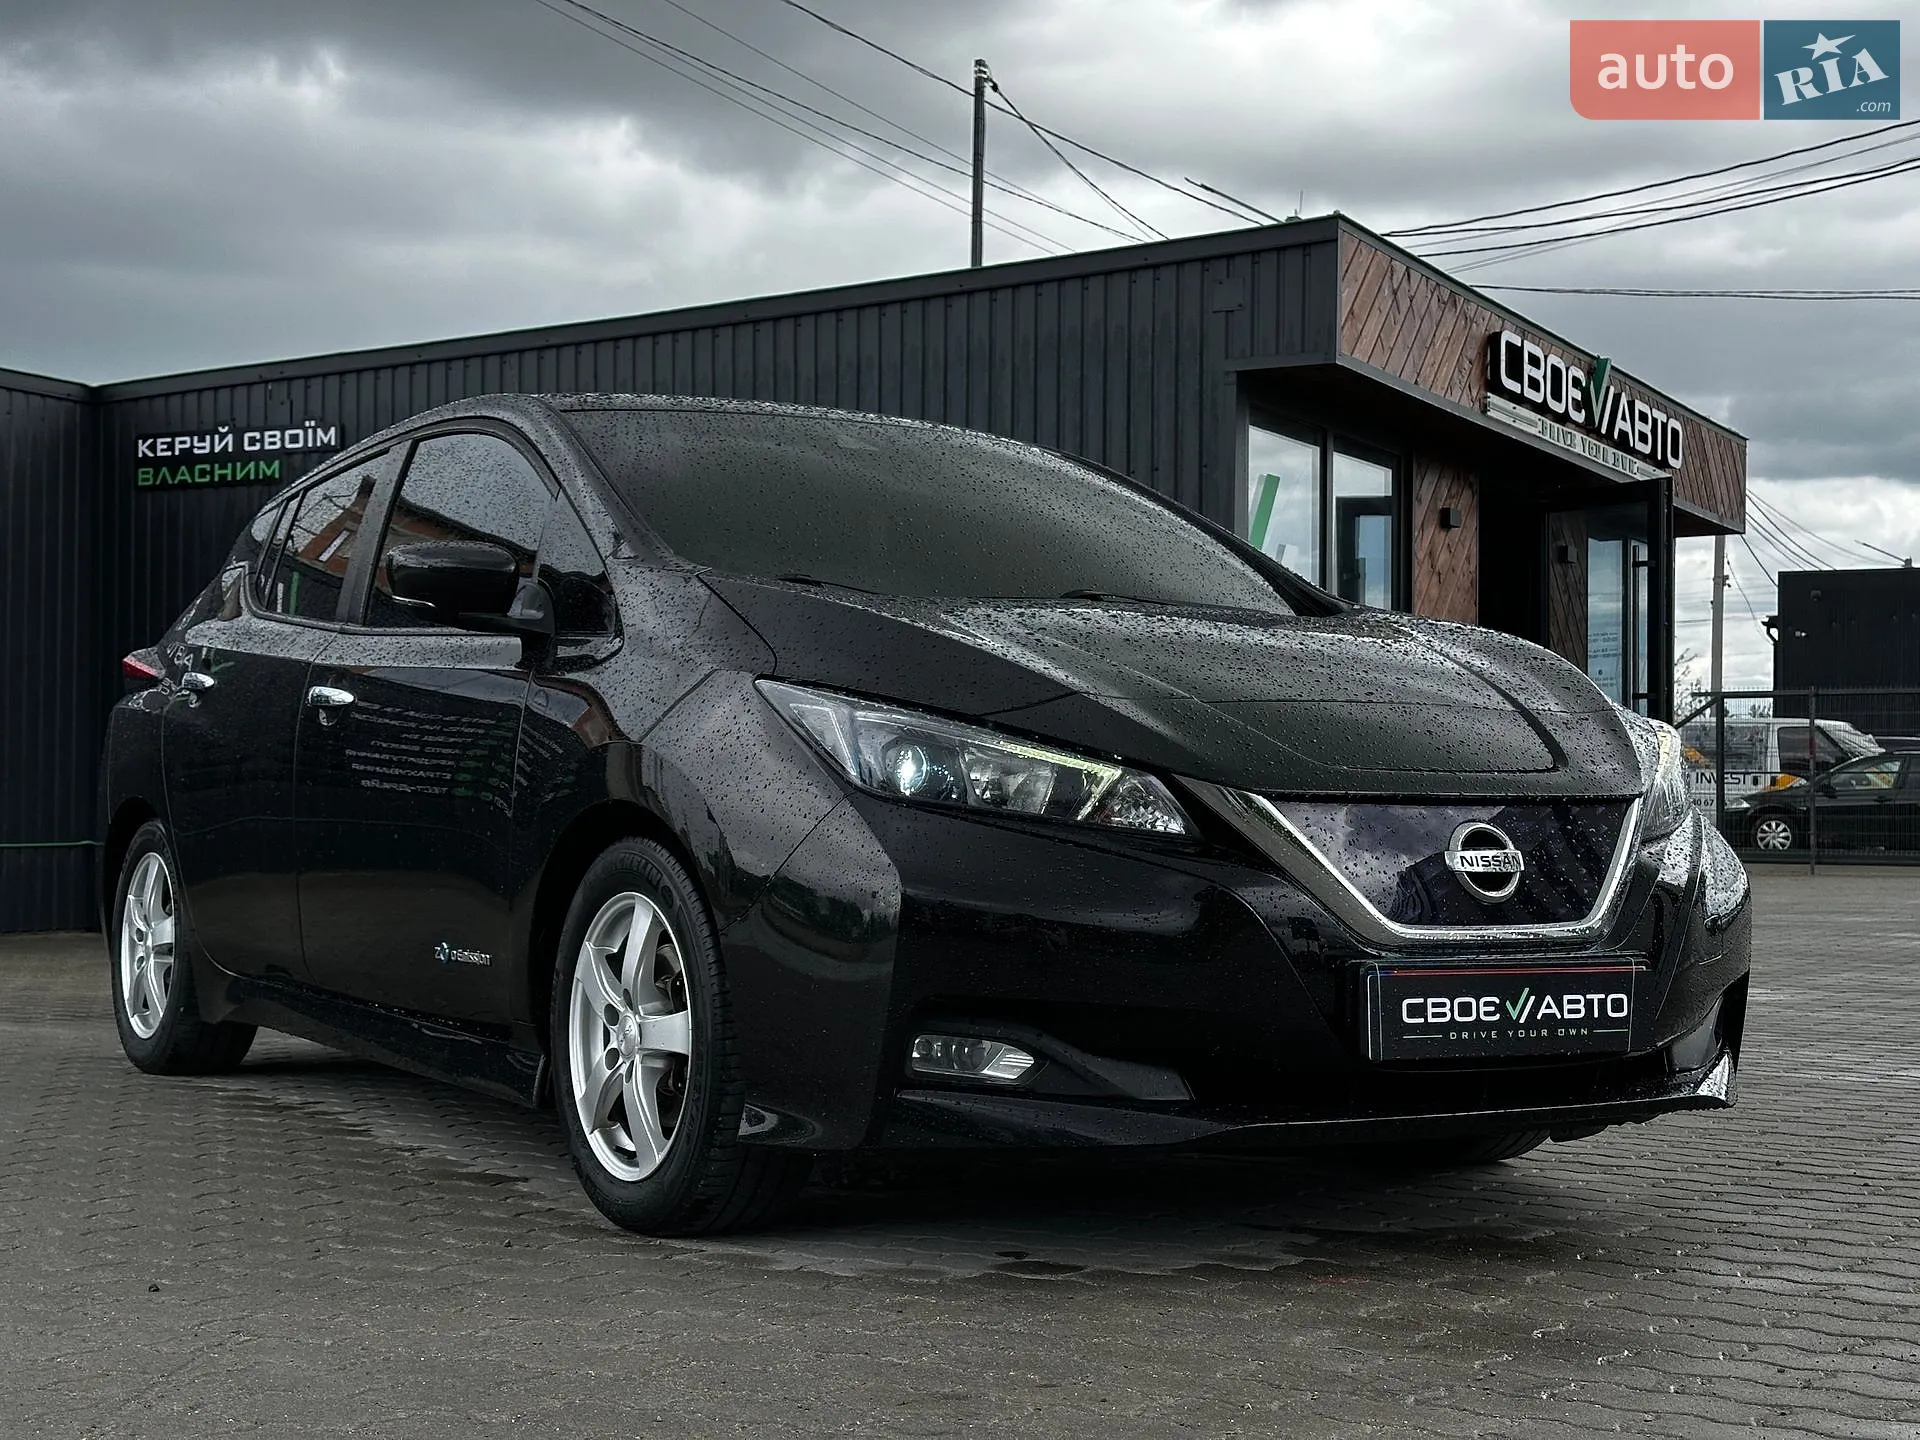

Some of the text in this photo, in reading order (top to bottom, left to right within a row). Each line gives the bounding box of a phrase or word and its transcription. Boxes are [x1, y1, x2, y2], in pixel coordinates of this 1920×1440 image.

[137, 420, 337, 458] КЕРУЙ СВОЇМ
[137, 460, 280, 486] ВЛАСНИМ
[1459, 854, 1521, 867] NISSAN
[1450, 1027, 1588, 1040] DRIVE YOUR OWN
